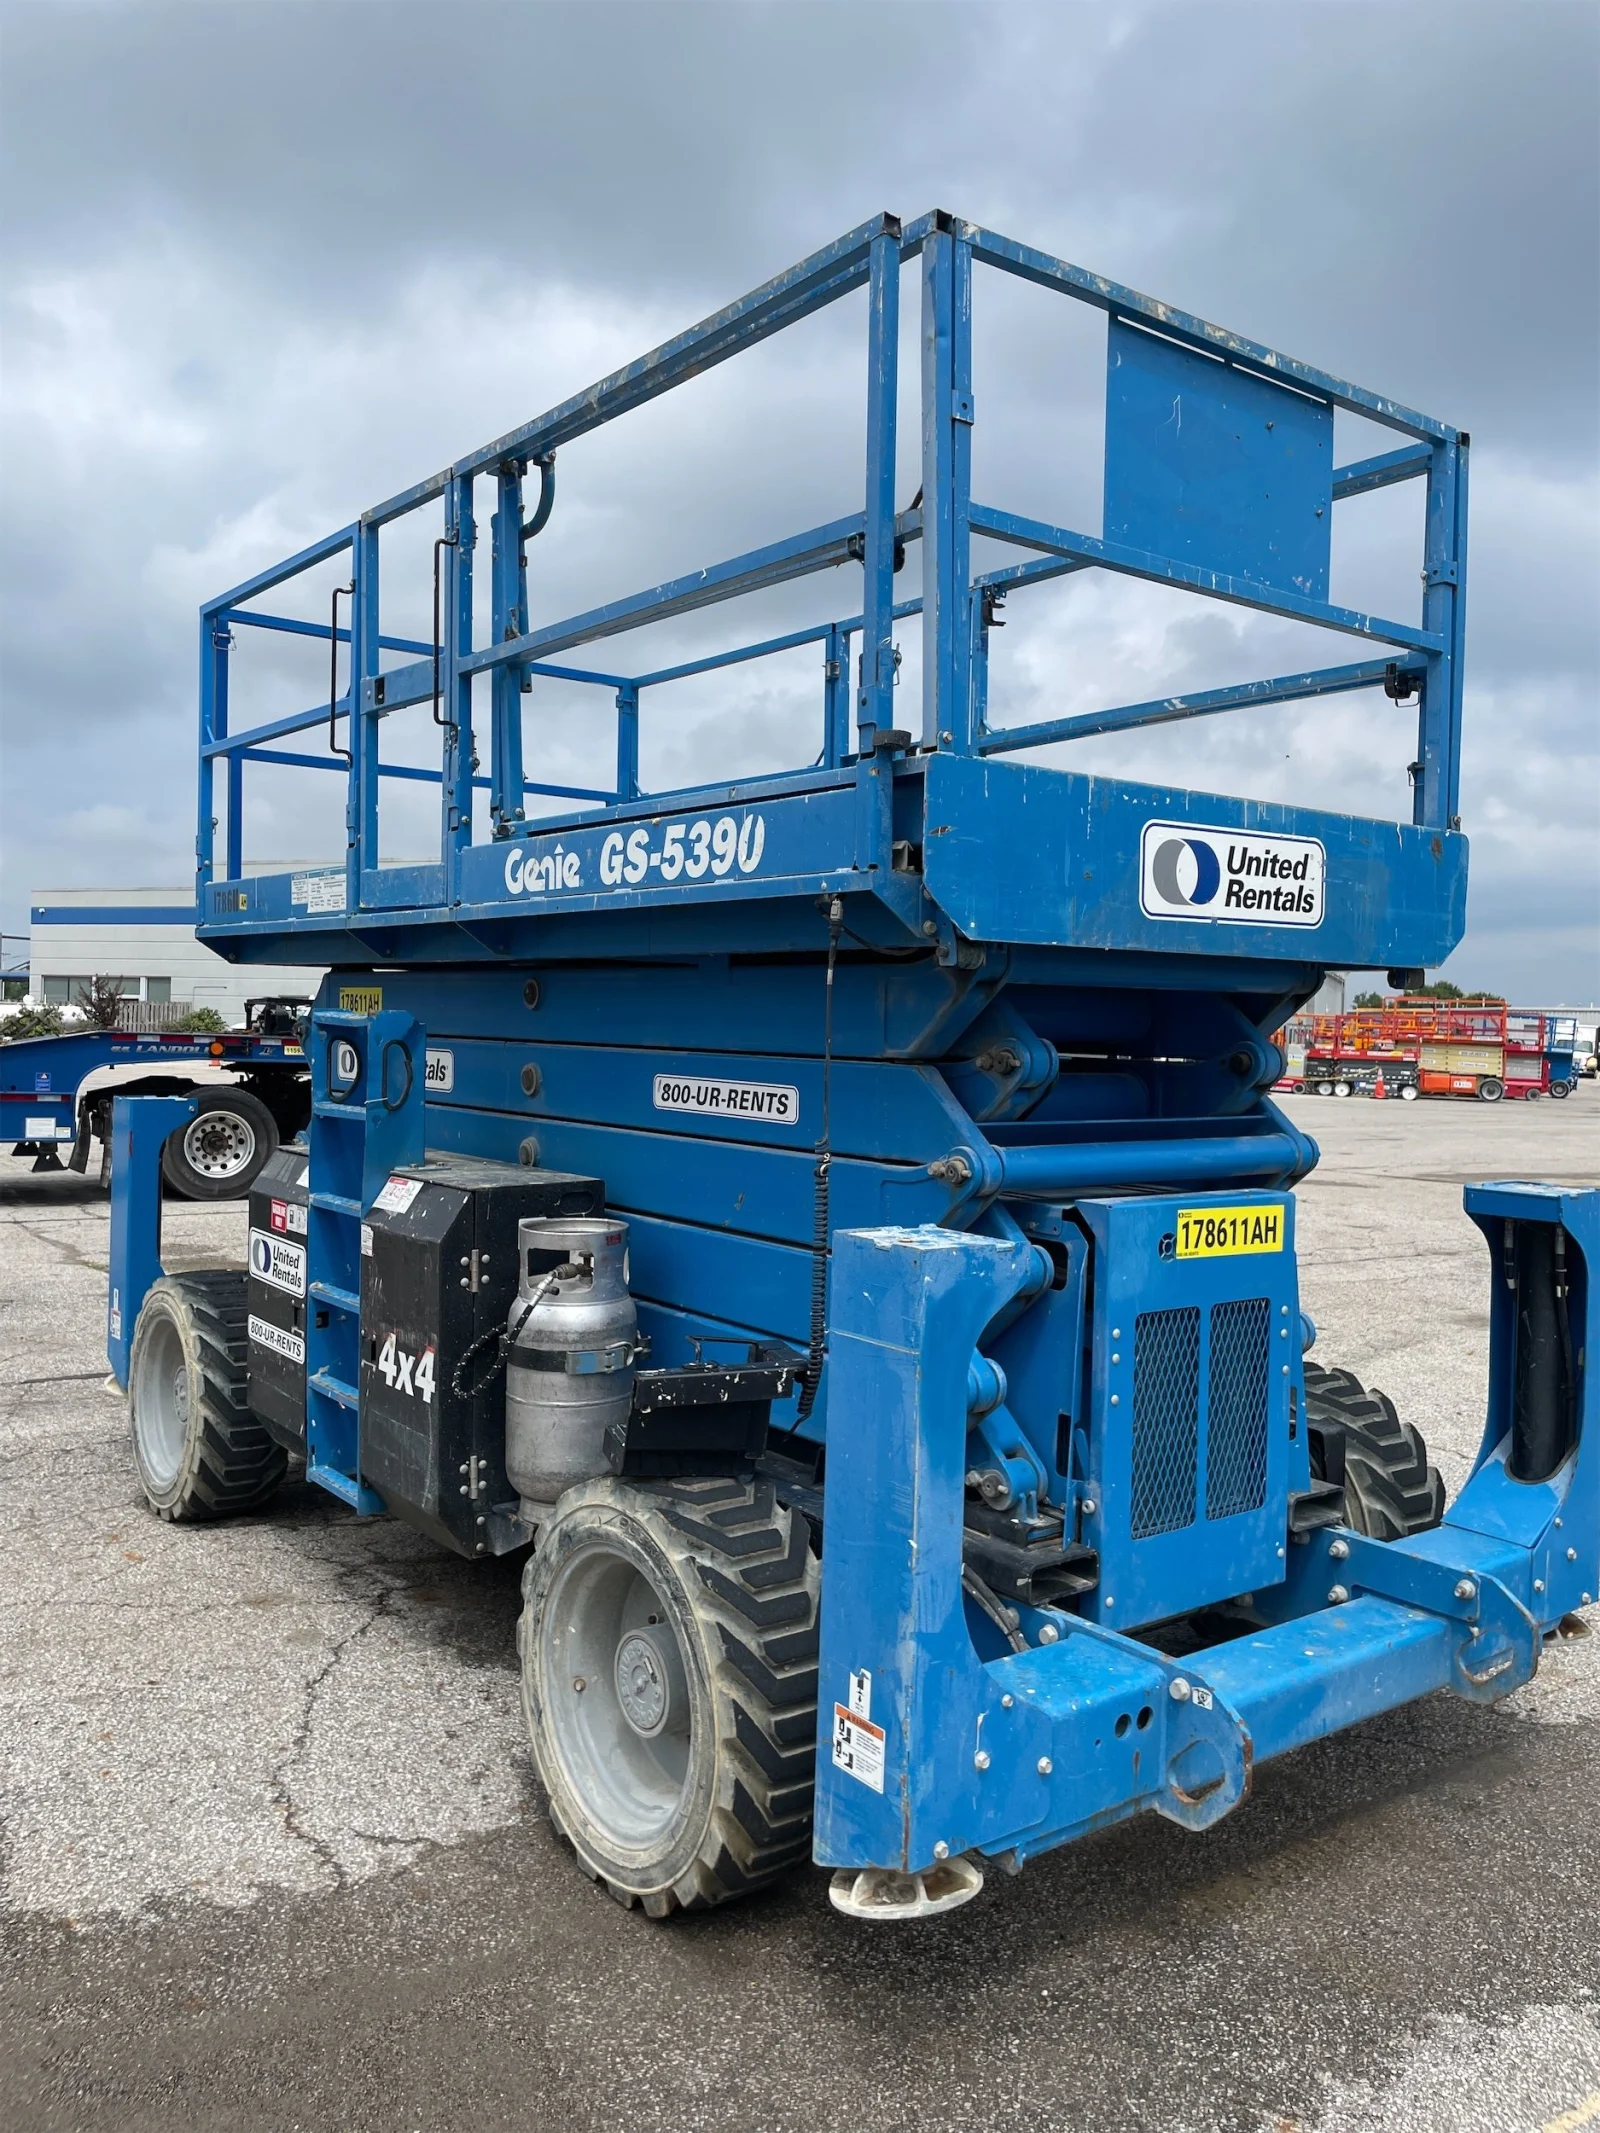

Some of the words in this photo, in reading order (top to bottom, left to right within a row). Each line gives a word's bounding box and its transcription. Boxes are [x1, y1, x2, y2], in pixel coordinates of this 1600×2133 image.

[505, 843, 581, 895] Genie
[600, 814, 765, 886] GS-5390
[1226, 845, 1310, 881] United
[1225, 879, 1315, 914] Rentals
[341, 993, 380, 1012] 178611AH
[661, 1083, 789, 1115] 800-UR-RENTS
[1182, 1215, 1277, 1249] 178611AH
[273, 1245, 300, 1270] United
[272, 1263, 302, 1289] Rentals
[251, 1321, 302, 1358] 800-UR-RENTS
[379, 1333, 436, 1404] 4x4
